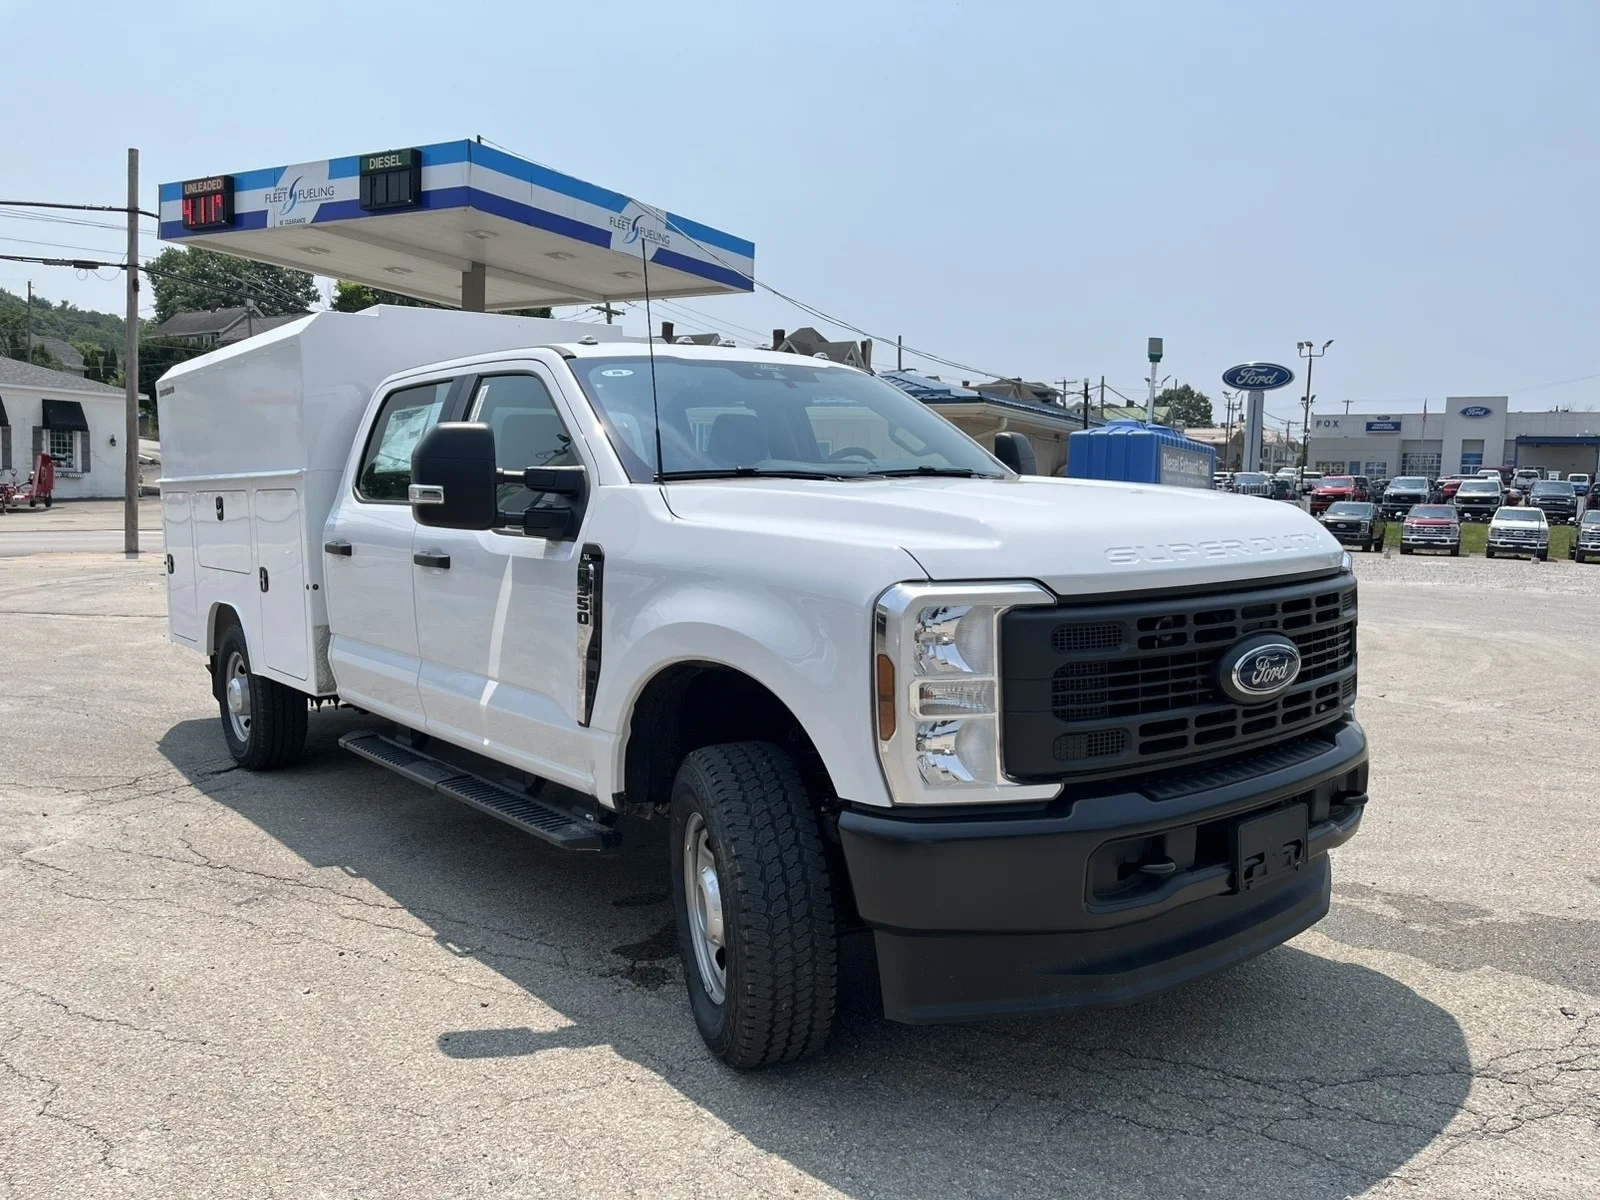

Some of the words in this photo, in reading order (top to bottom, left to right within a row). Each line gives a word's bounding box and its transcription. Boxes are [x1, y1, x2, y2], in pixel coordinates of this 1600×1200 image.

[369, 154, 402, 170] DIESEL
[184, 179, 222, 194] UNLEADED
[264, 191, 288, 203] FLEET
[298, 185, 335, 200] FUELING
[284, 217, 306, 225] CLEARANCE
[609, 216, 631, 231] FLEET
[640, 226, 670, 245] FUELING
[1236, 366, 1278, 385] Ford
[1315, 420, 1339, 428] FOX
[1163, 452, 1180, 472] Diesel
[582, 553, 592, 561] XL
[1251, 654, 1289, 685] Ford
